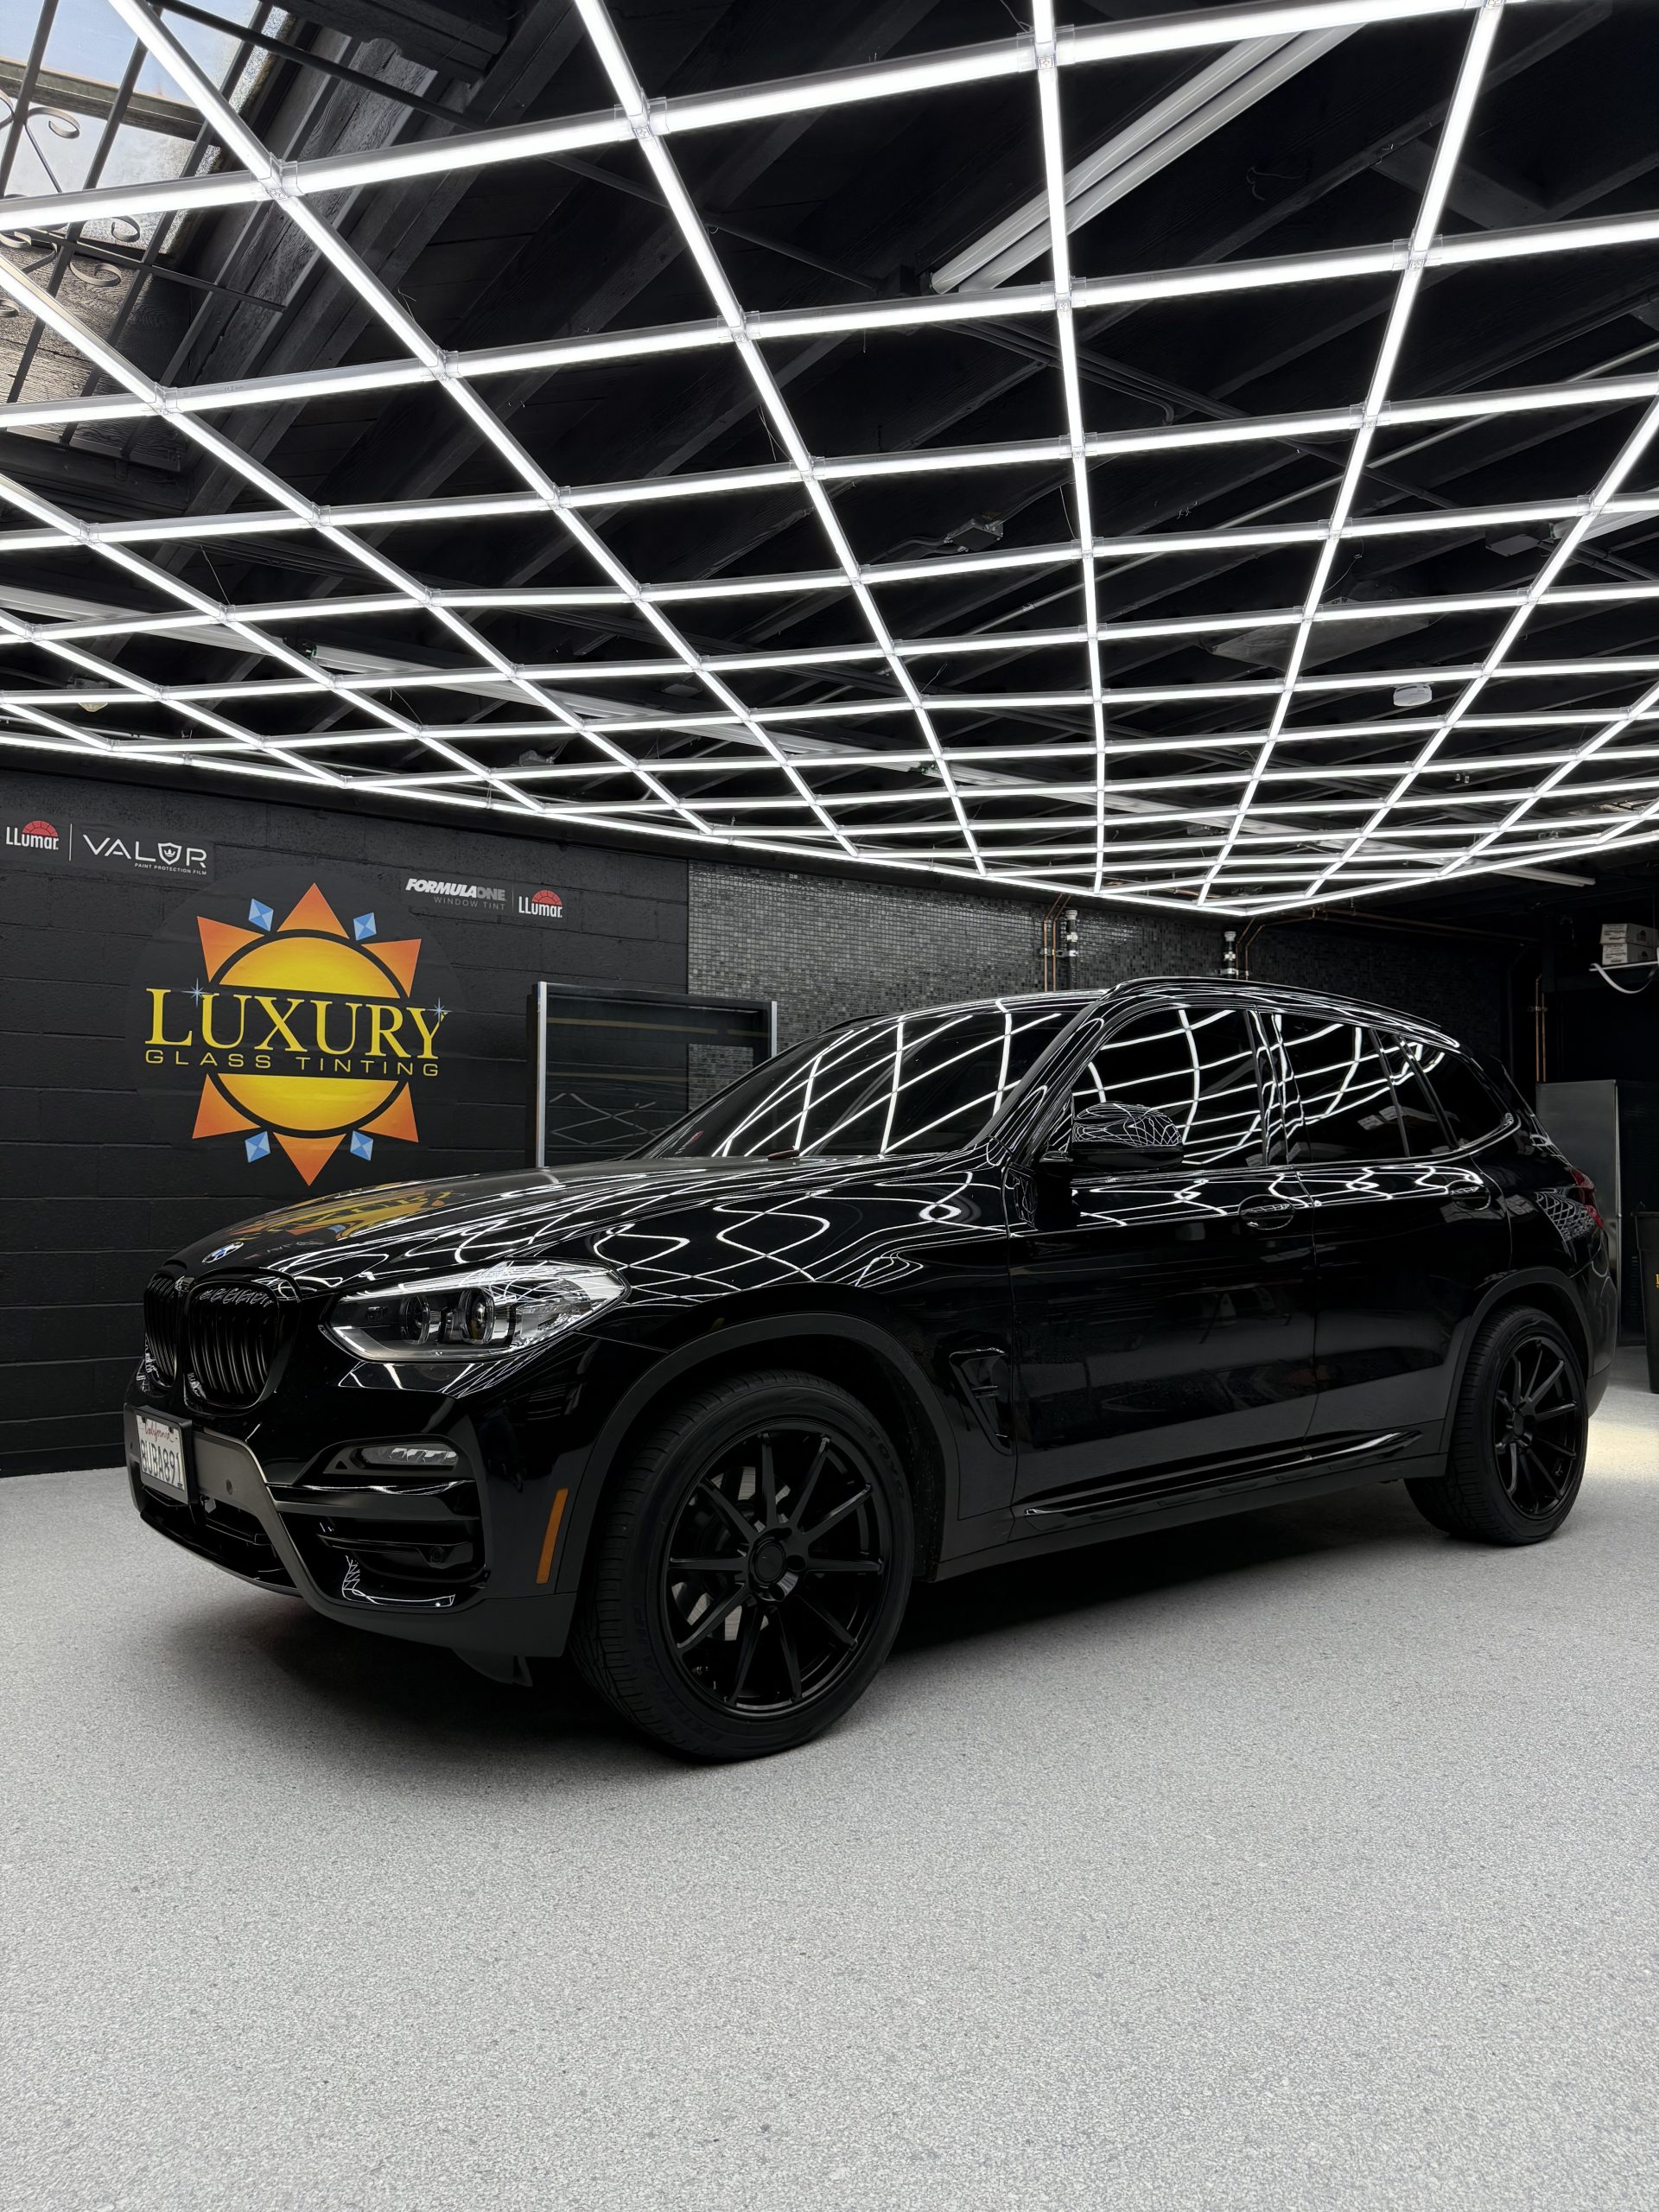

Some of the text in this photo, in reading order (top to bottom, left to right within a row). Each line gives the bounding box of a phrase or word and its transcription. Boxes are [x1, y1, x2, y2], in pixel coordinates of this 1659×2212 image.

[6, 826, 58, 850] LLumar
[154, 865, 192, 874] PROTECTION
[434, 896, 505, 910] WINDOW TINT
[518, 895, 563, 918] LLumar
[144, 988, 449, 1060] LUXURY
[144, 1049, 438, 1077] GLASS TINTING
